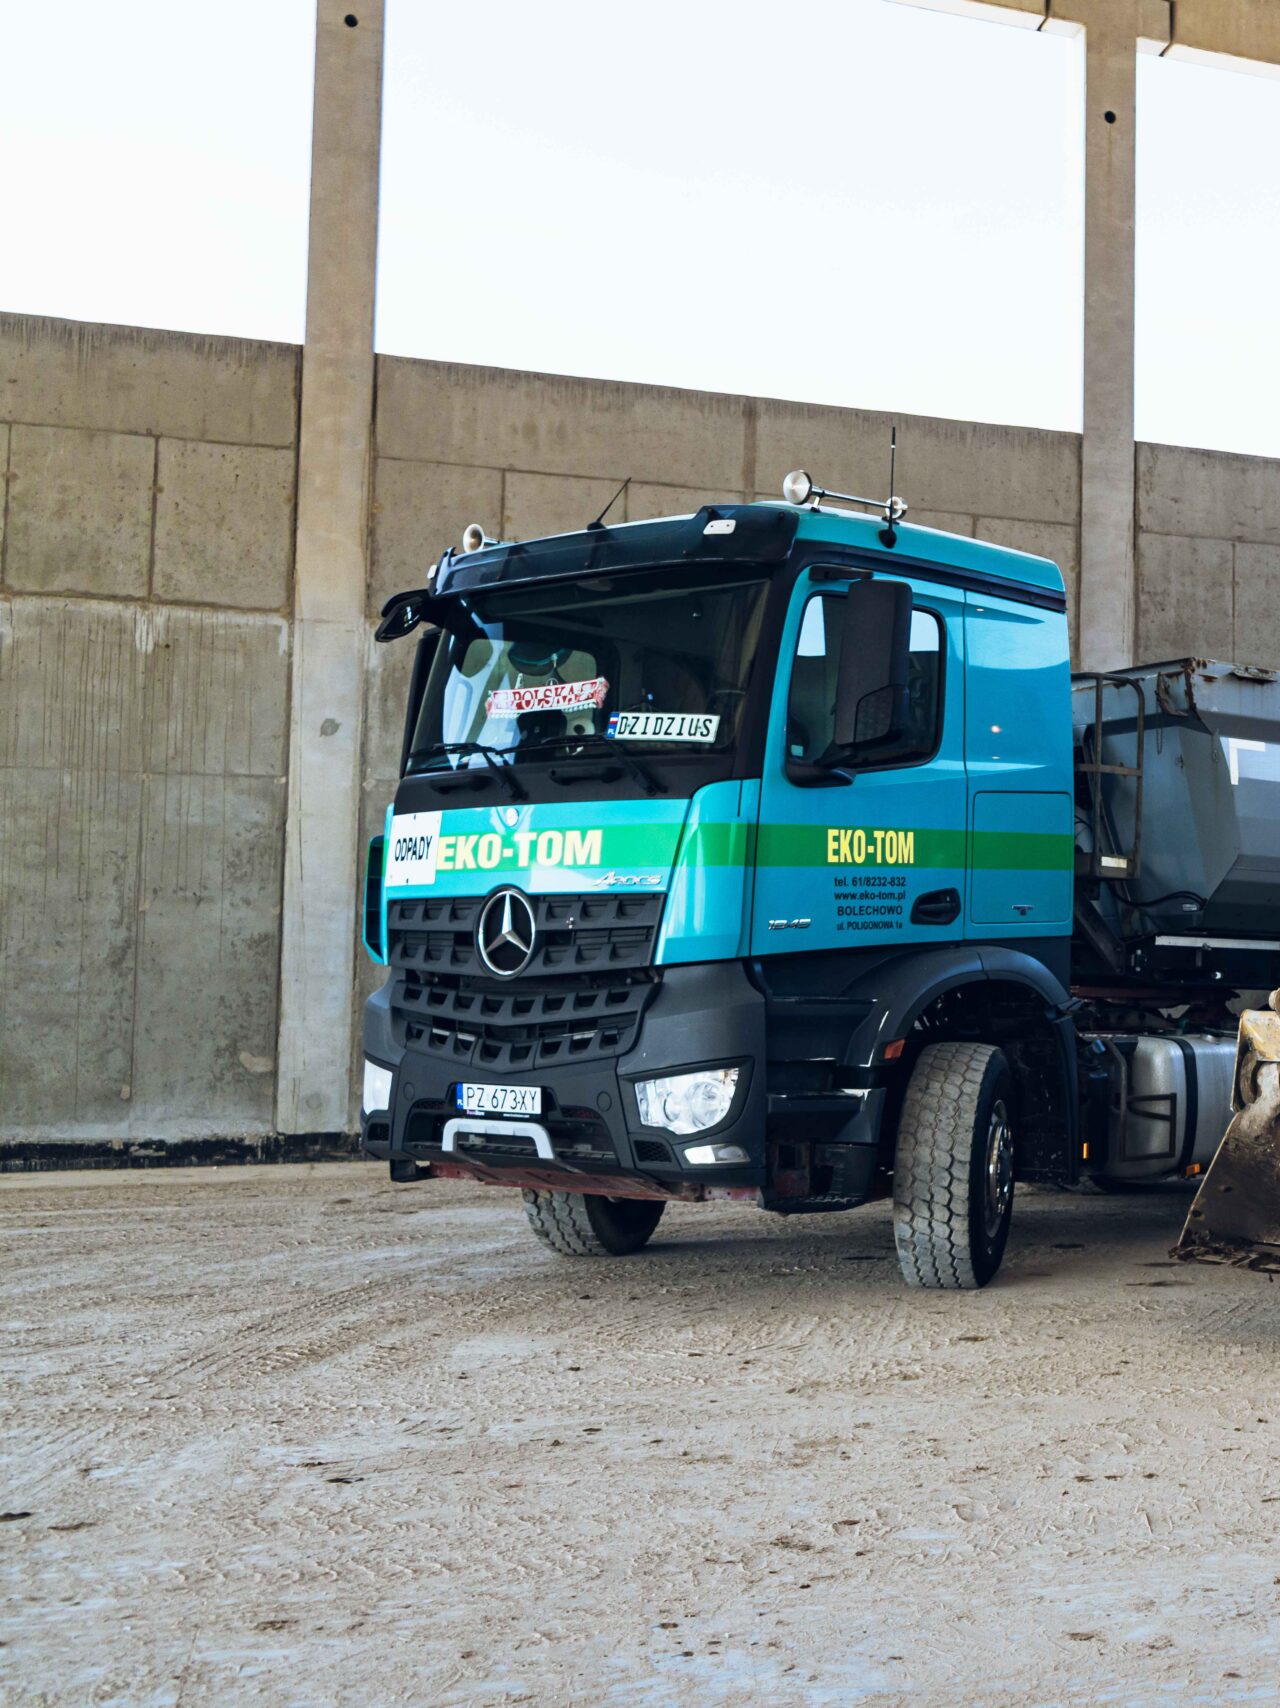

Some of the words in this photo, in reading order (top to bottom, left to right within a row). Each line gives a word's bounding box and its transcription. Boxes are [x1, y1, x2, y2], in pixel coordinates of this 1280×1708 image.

[512, 684, 579, 710] POLSKA
[394, 835, 433, 862] ODPADY
[436, 829, 603, 871] EKO-TOM
[827, 829, 914, 864] EKO-TOM
[834, 876, 849, 887] tel.
[851, 876, 906, 887] 61/8232-832
[834, 890, 906, 902] www.eko-tom.pl
[837, 905, 903, 916] BOLECHOWO
[467, 1087, 485, 1108] PZ
